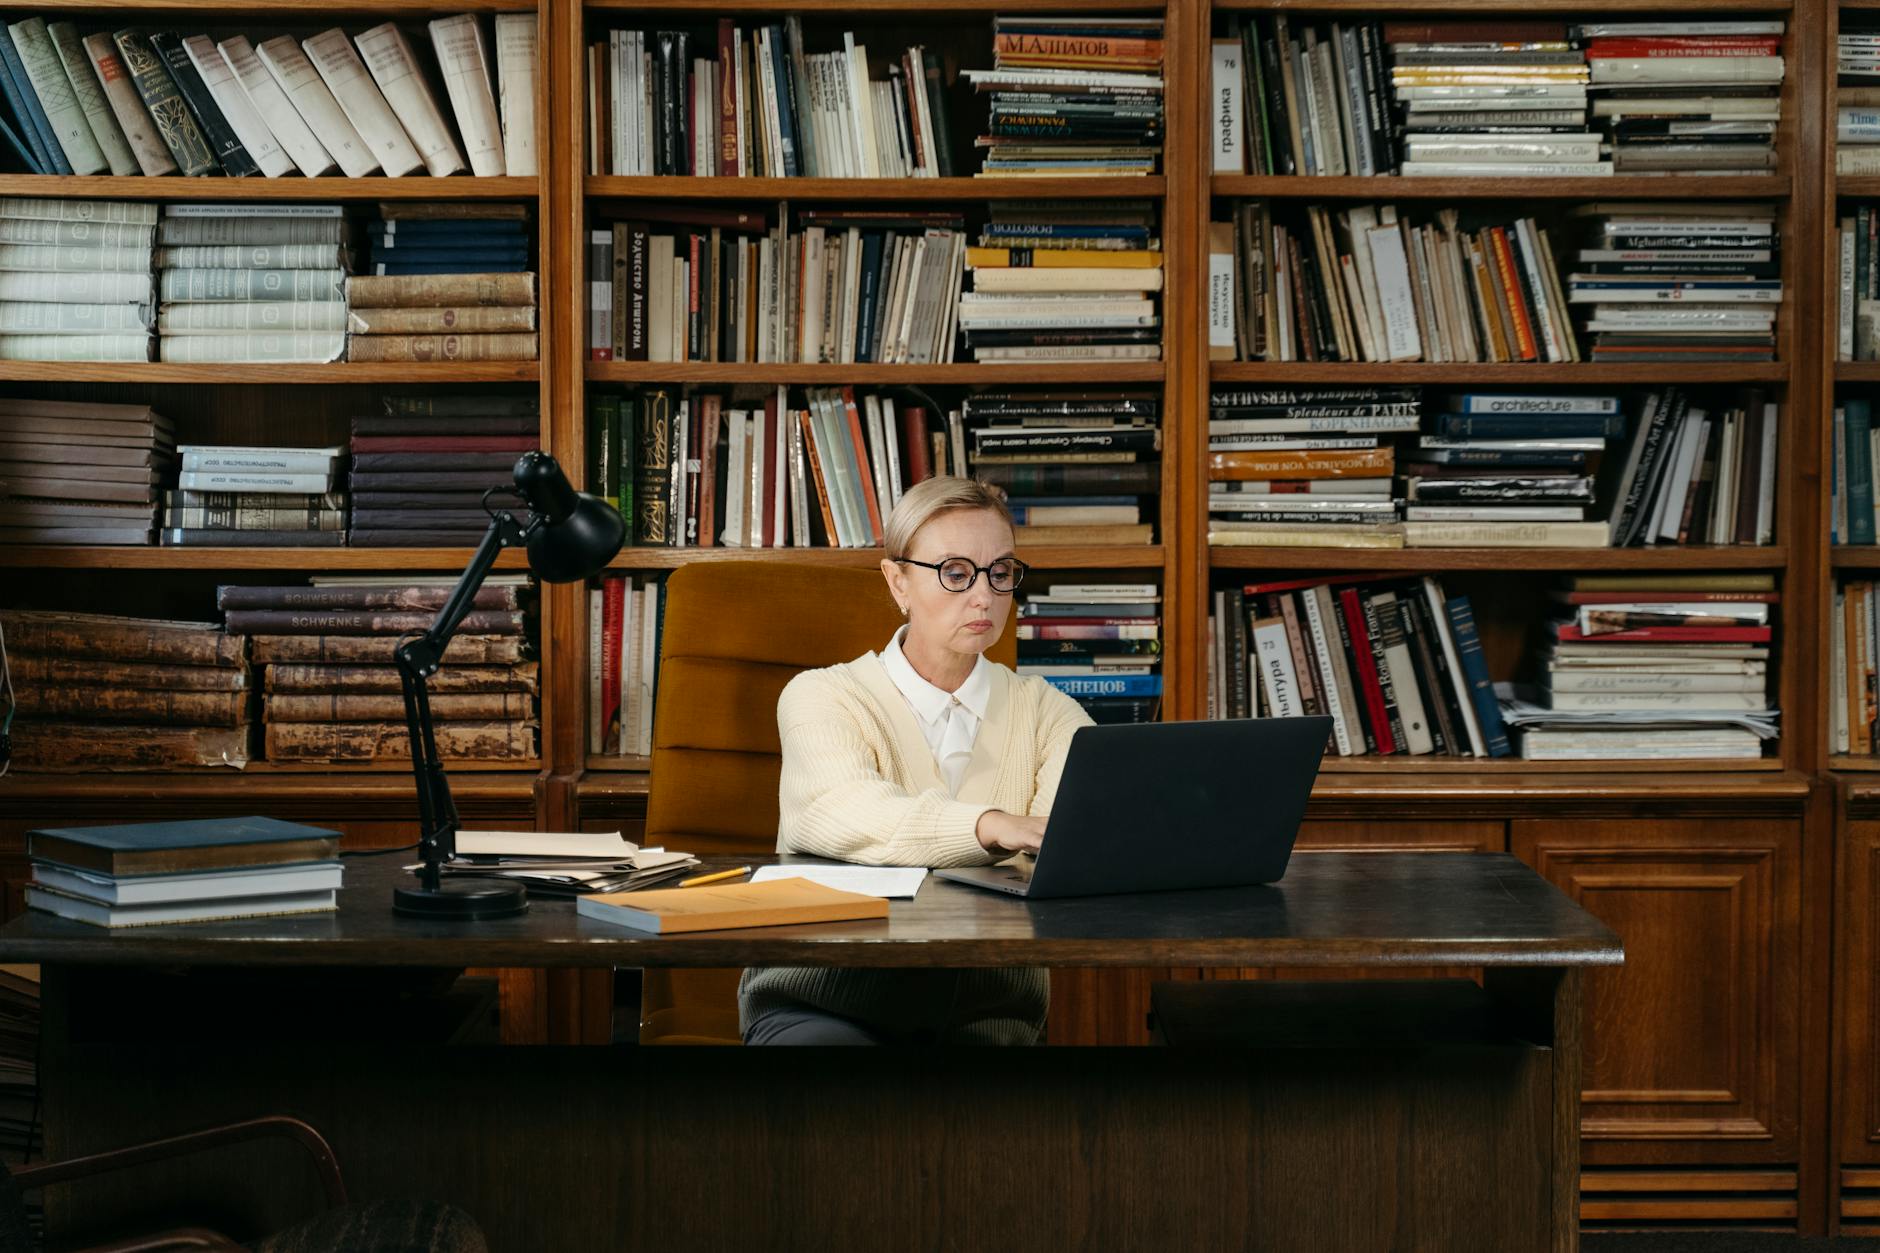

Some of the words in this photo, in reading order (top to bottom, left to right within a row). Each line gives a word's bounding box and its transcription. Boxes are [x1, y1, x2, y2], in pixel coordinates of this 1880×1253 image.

[1004, 35, 1109, 56] М.АЛПАТОВ
[1219, 88, 1234, 153] графика
[1627, 236, 1689, 248] Afghanistan
[631, 231, 645, 290] Зодчество
[1222, 273, 1230, 328] Искусство
[632, 293, 644, 349] Апшерона
[1212, 391, 1297, 406] VERSAILLES
[1300, 392, 1314, 402] de
[1317, 389, 1378, 402] Splendeurs
[1287, 406, 1350, 419] Splendeurs
[1353, 407, 1366, 417] de
[1371, 404, 1417, 417] PARIS
[1491, 398, 1572, 413] architecture
[284, 592, 355, 604] SCHWENKE
[291, 616, 361, 628] SCHWENKE
[1362, 599, 1380, 641] France
[1371, 641, 1384, 657] de
[1376, 658, 1392, 686] Rois
[1048, 680, 1126, 695] УЗНЕЦОВ
[1270, 659, 1291, 719] льптура
[1383, 687, 1398, 709] Les
